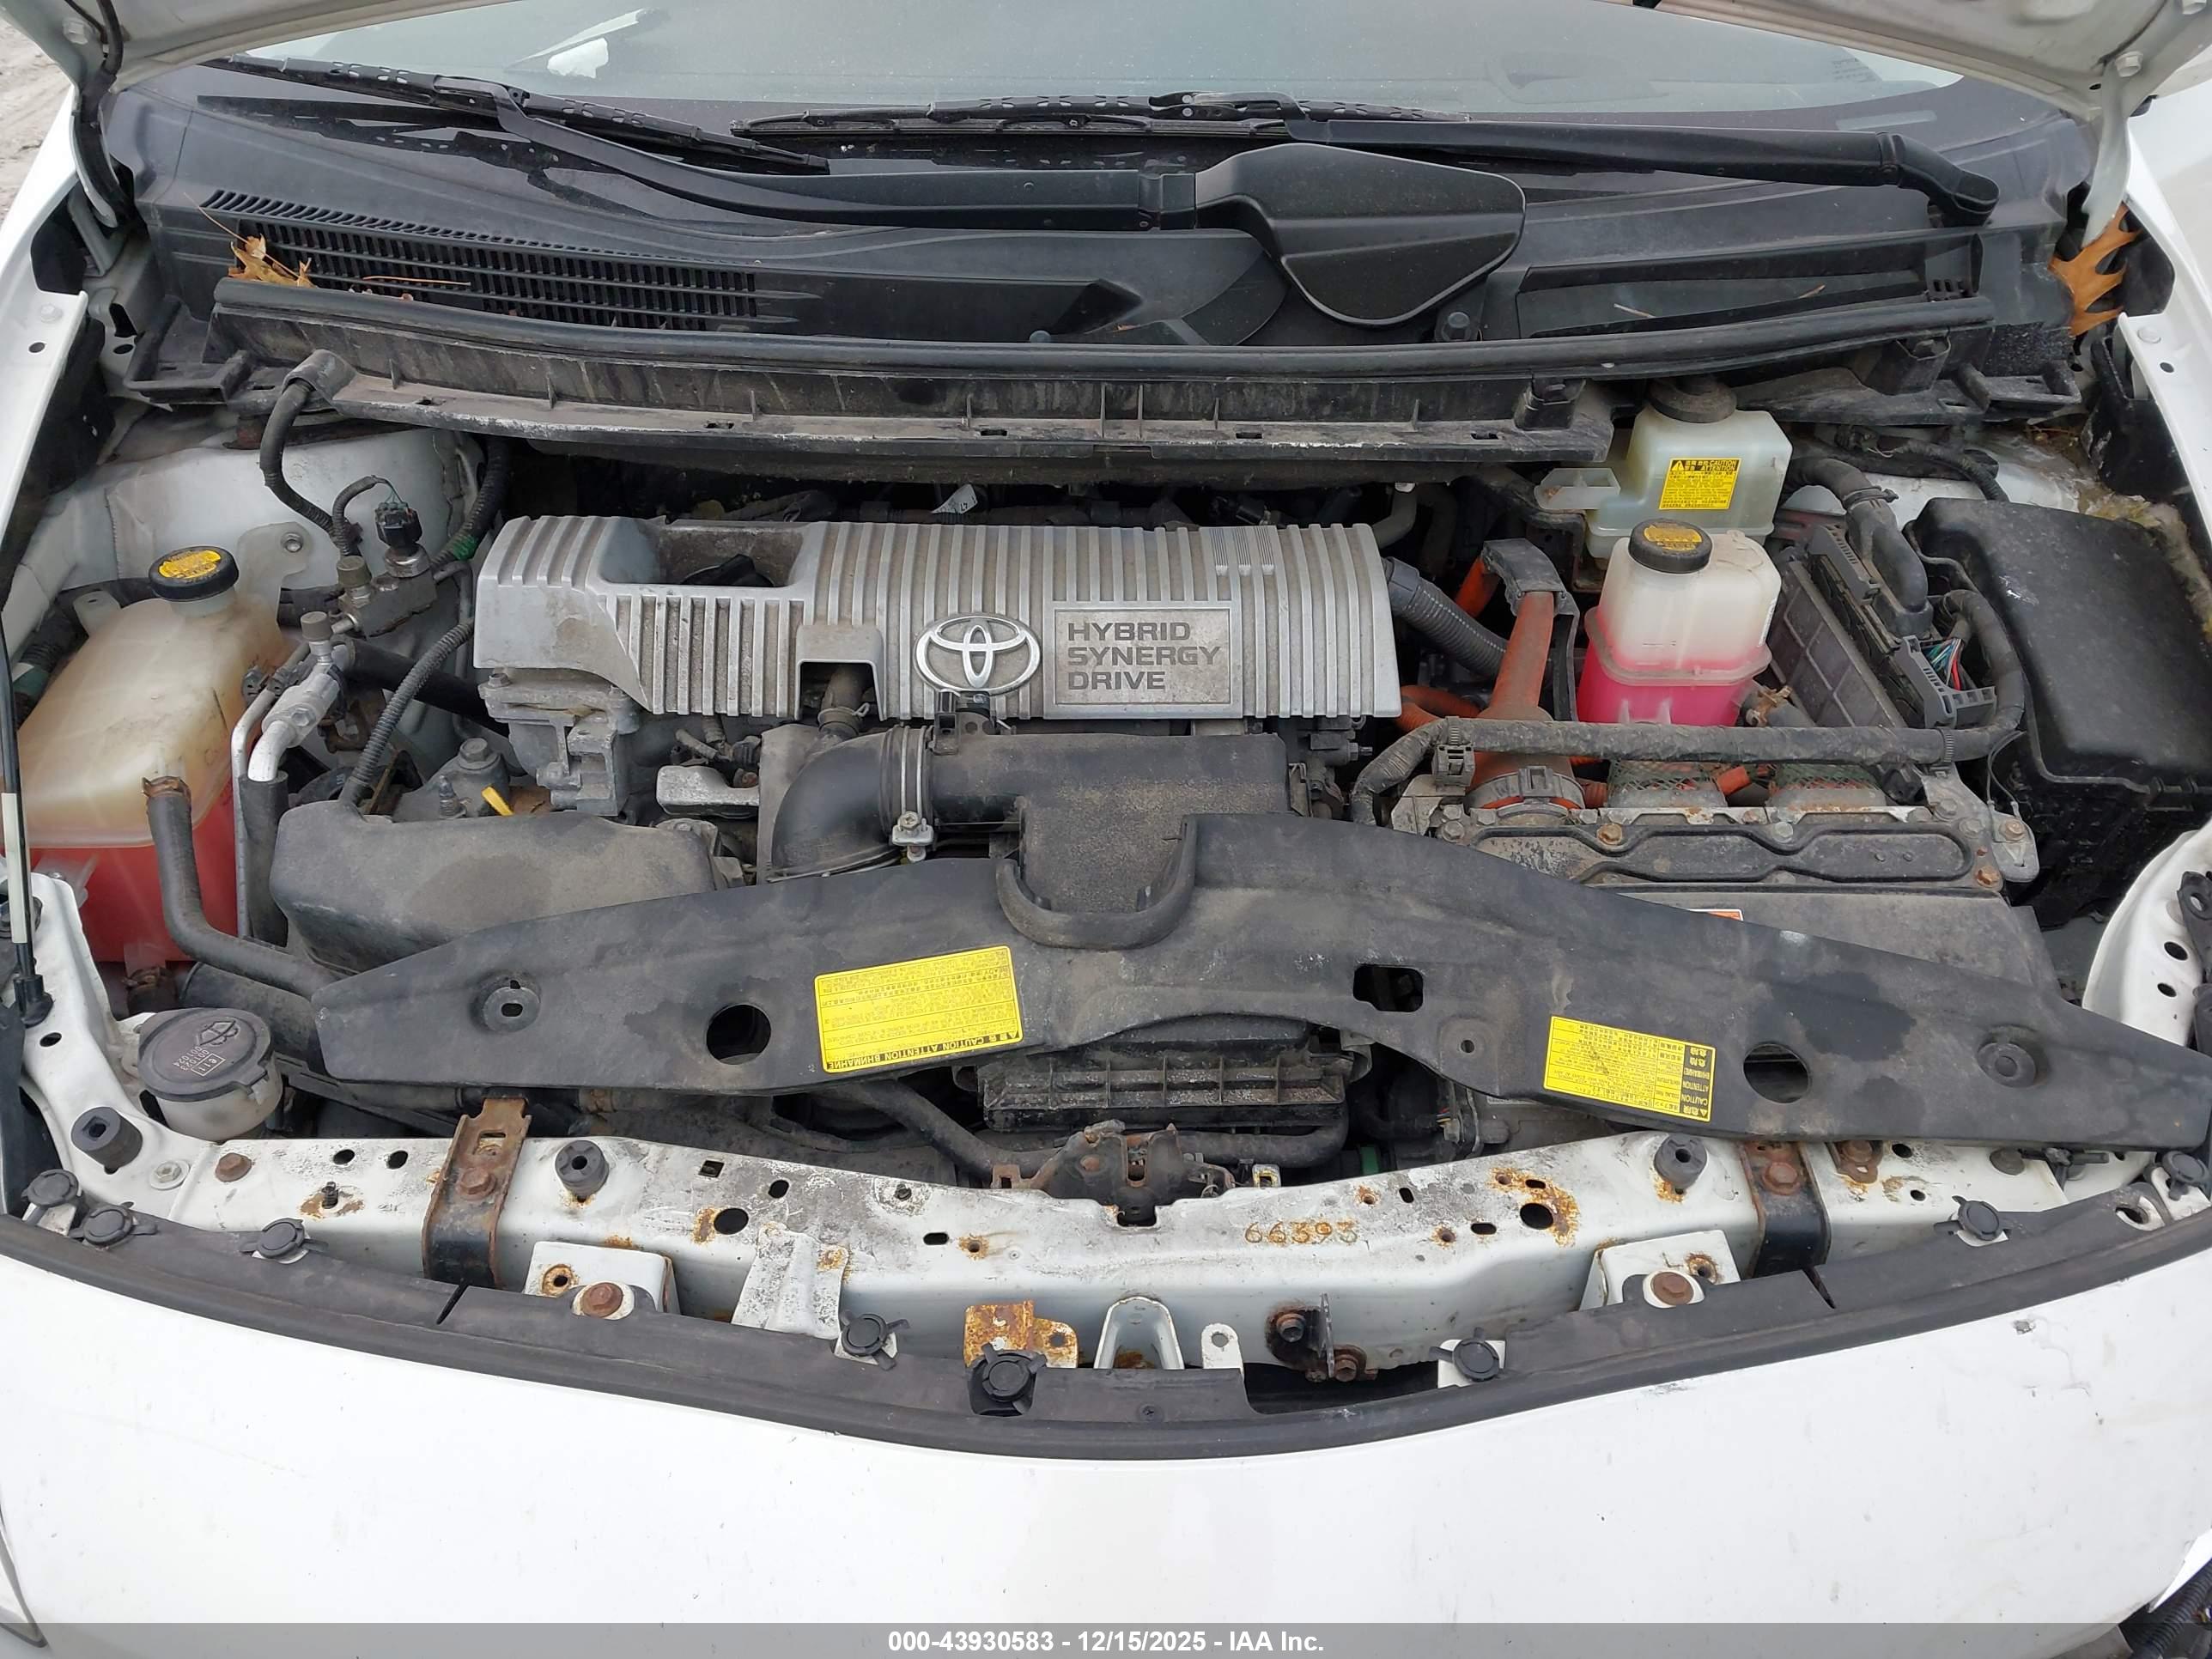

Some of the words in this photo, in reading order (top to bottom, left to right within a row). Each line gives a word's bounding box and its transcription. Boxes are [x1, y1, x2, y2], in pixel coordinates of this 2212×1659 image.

[1068, 622, 1191, 641] HYBRID
[1068, 647, 1220, 665] SYNERGY
[1068, 672, 1165, 690] DRIVE
[884, 1044, 938, 1060] ATTENTION
[942, 1036, 985, 1052] CAUTION
[827, 1054, 880, 1069] ВНИМАНИЕ
[1682, 1080, 1710, 1092] ATTENTION
[1680, 1094, 1708, 1106] CAUTION
[1245, 1221, 1358, 1243] 66393
